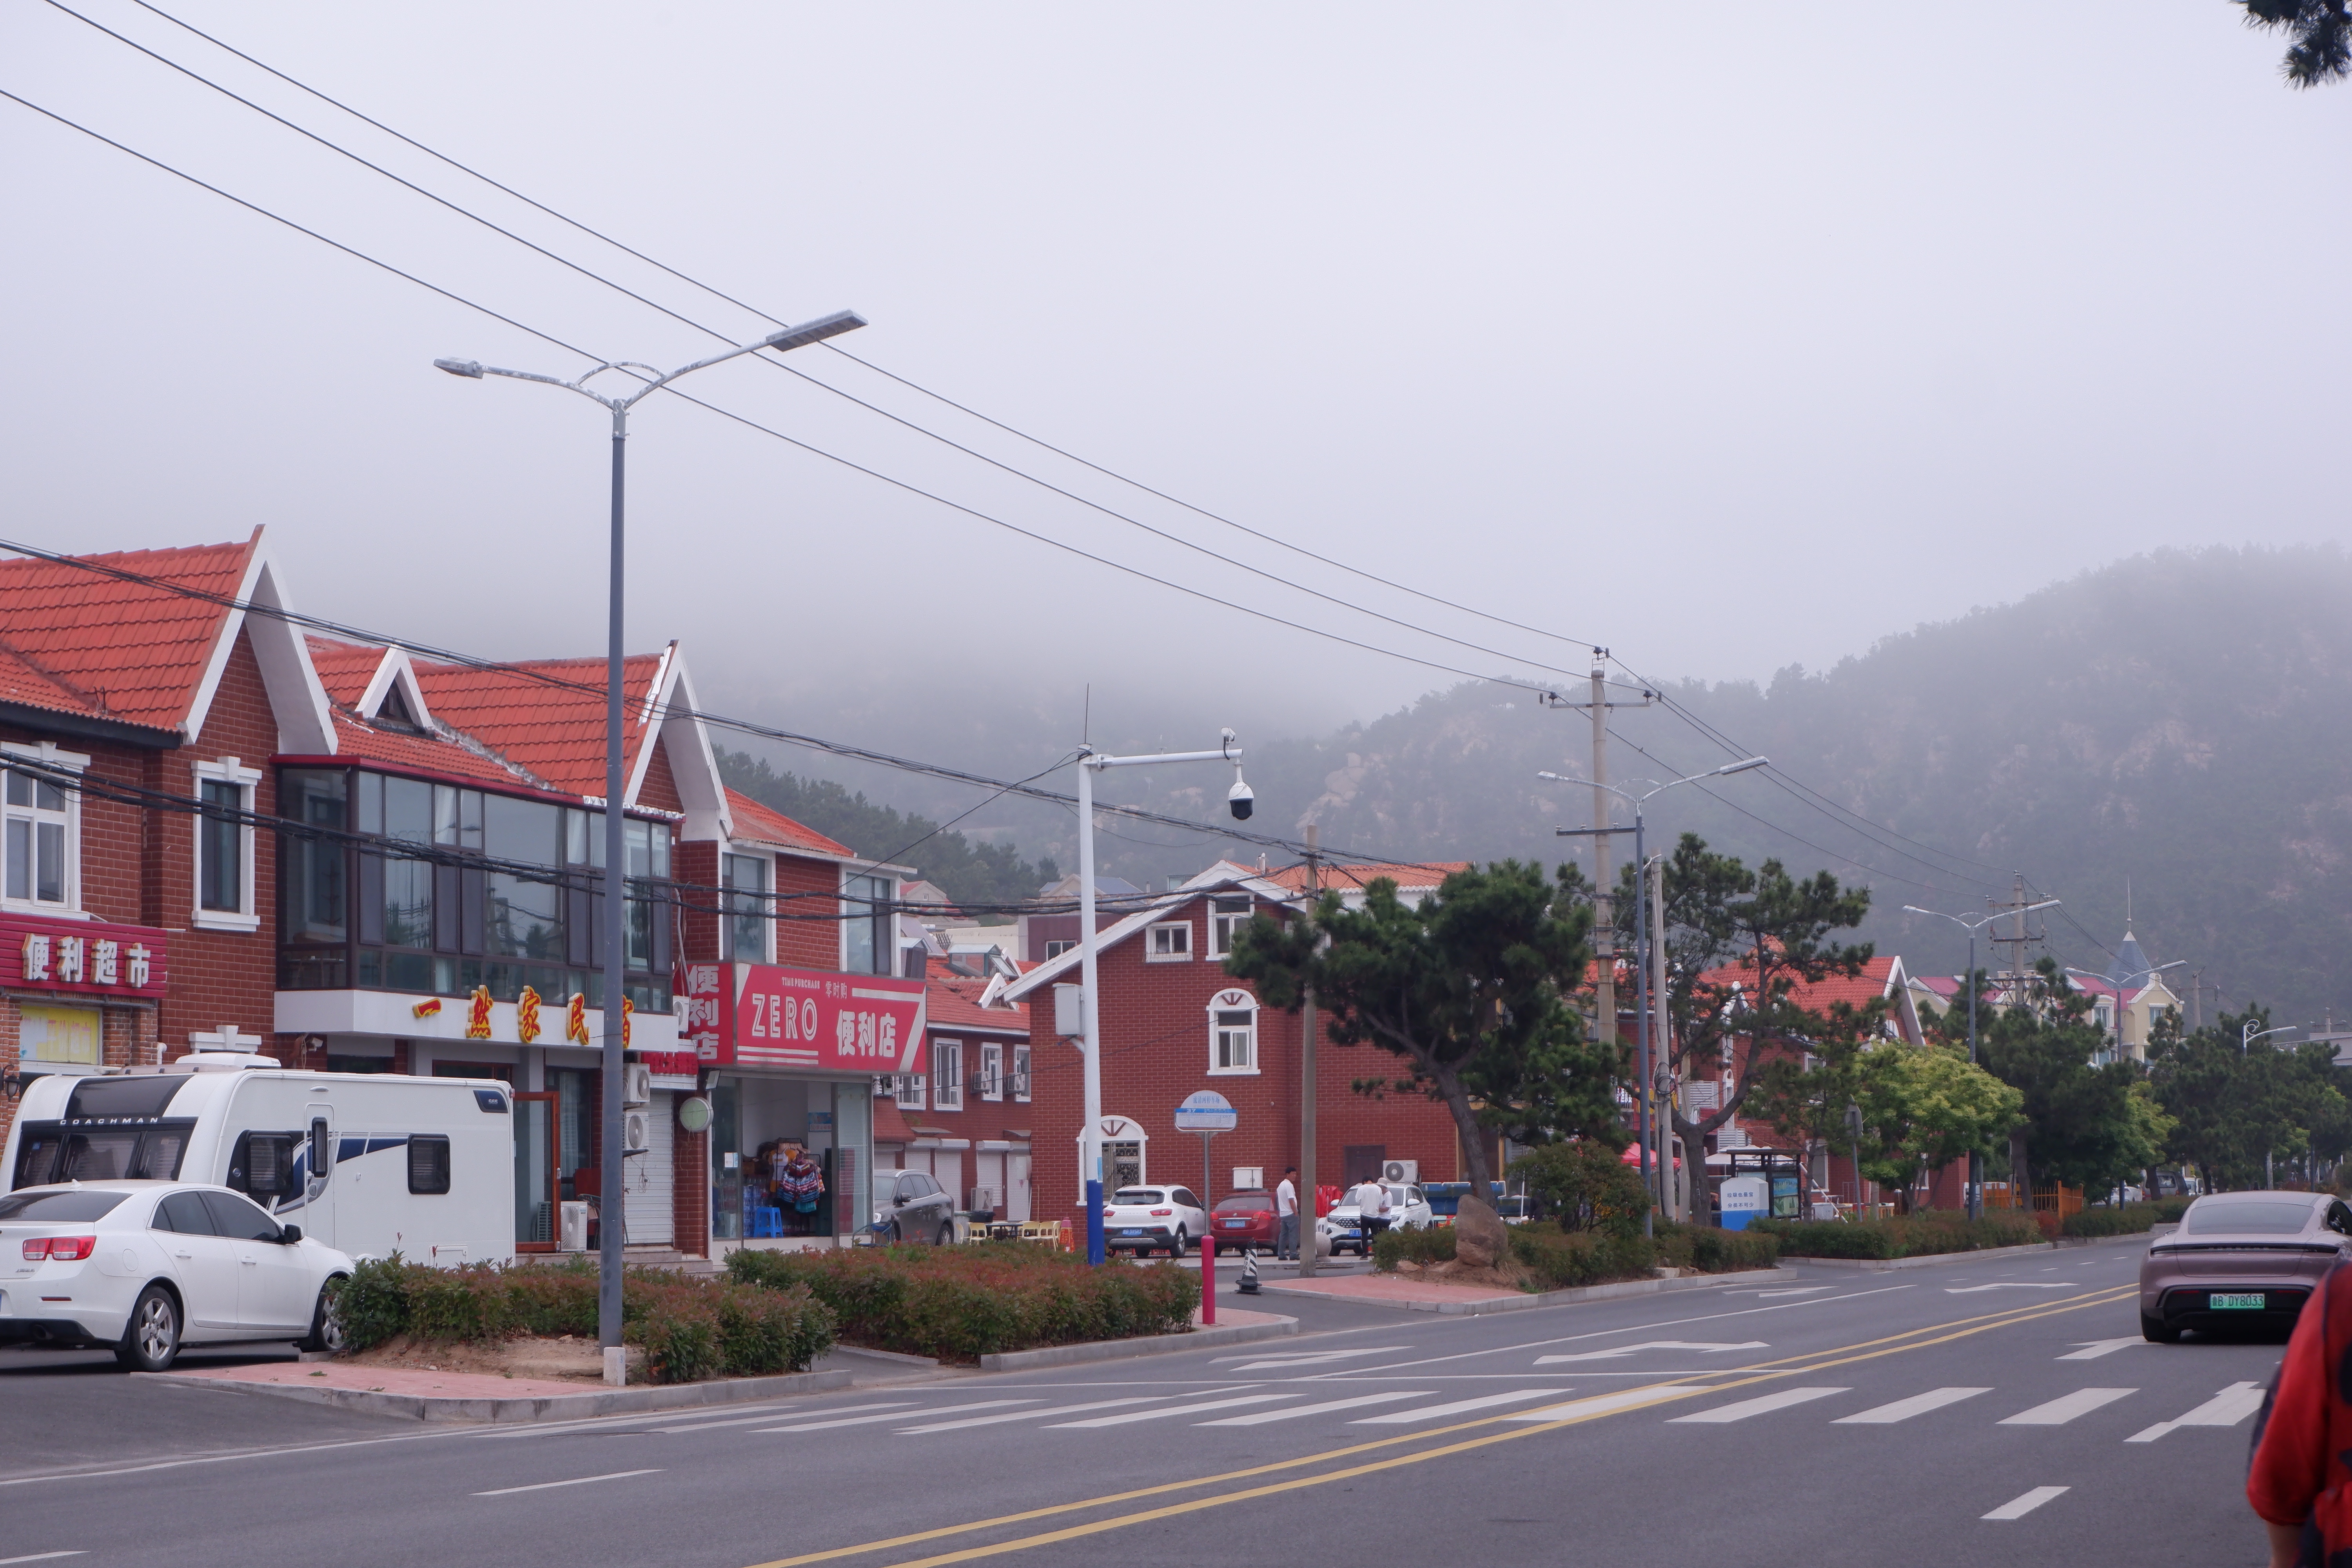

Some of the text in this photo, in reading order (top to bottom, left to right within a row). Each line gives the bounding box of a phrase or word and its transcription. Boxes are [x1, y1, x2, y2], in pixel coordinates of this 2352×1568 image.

[22, 933, 151, 988] 便利超市
[689, 965, 719, 1059] 便利店
[826, 981, 847, 999] 零时购
[752, 993, 817, 1040] ZERO
[836, 1009, 896, 1057] 便利店
